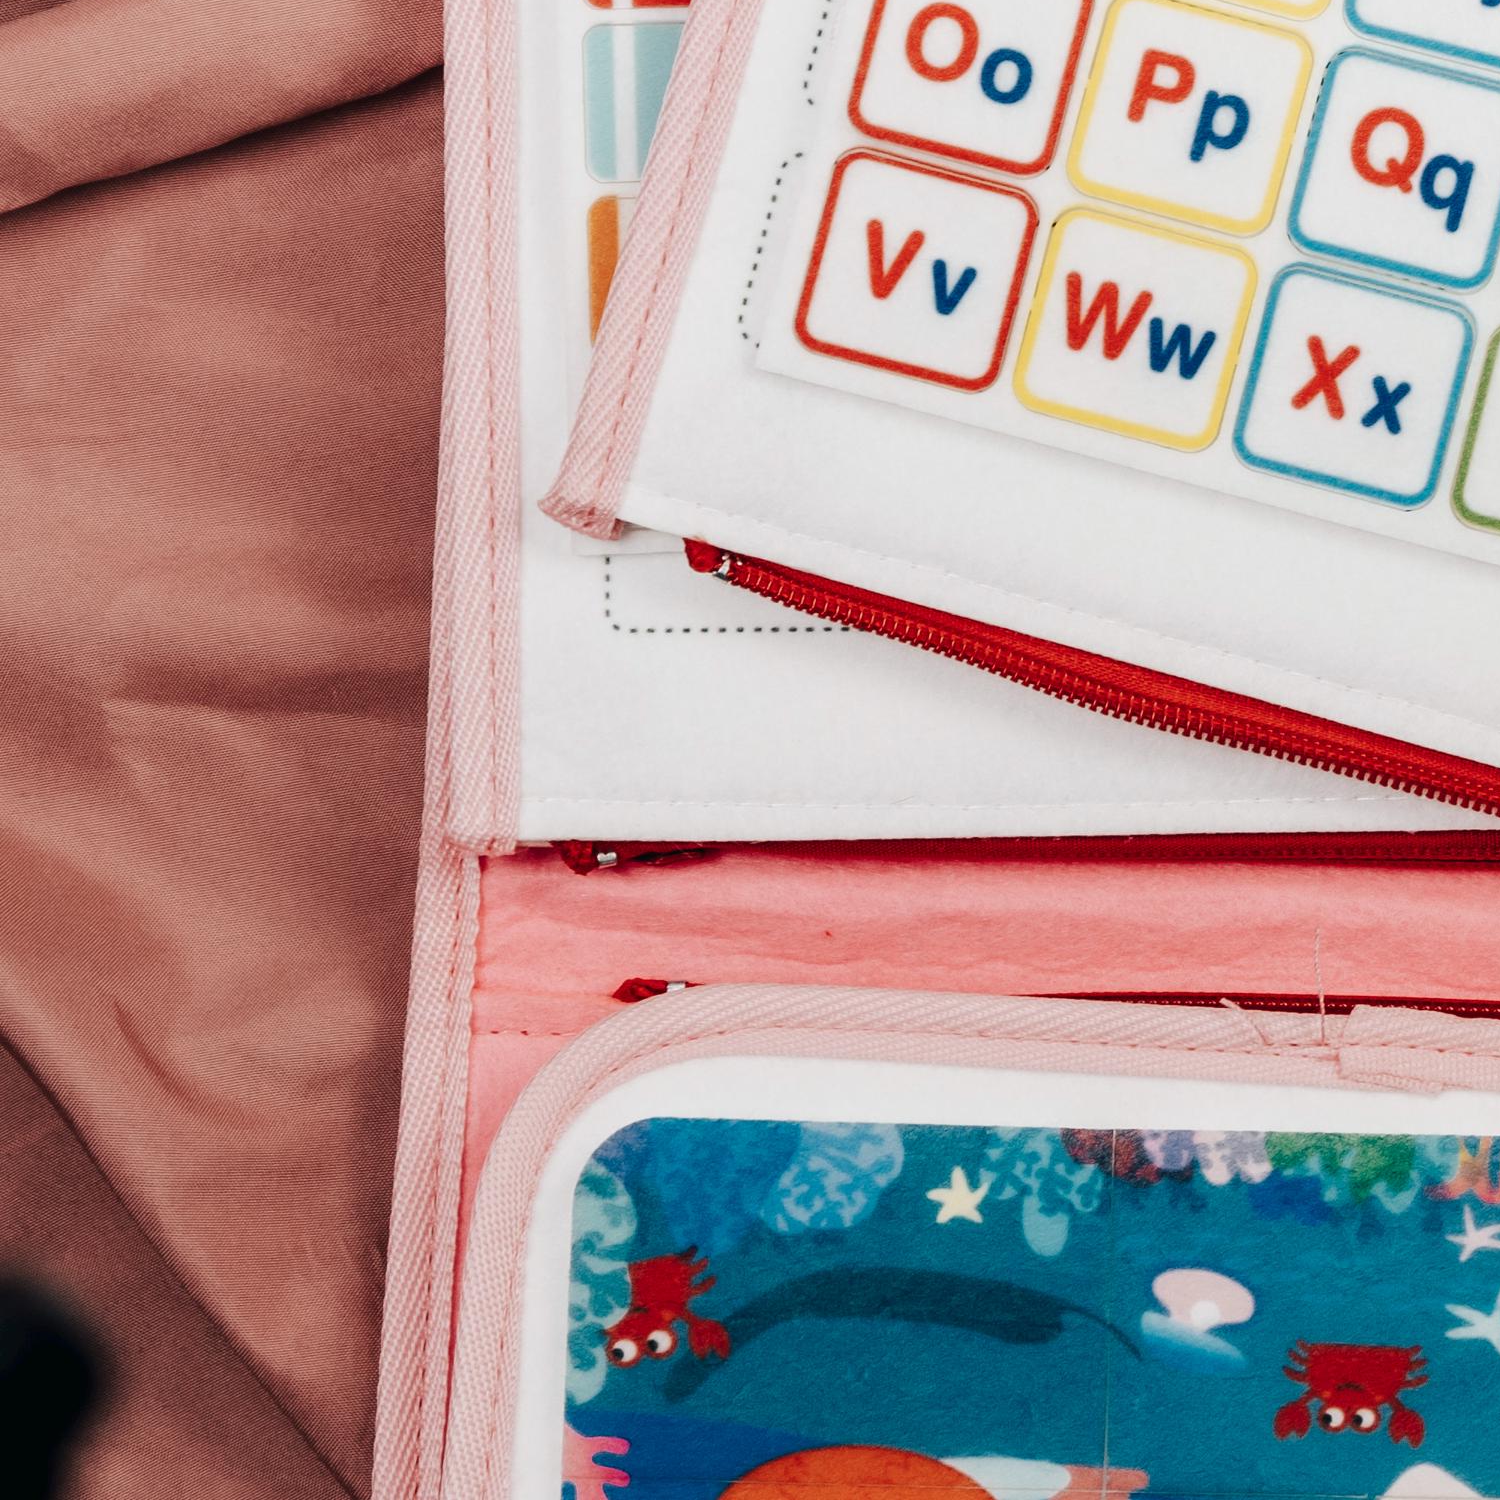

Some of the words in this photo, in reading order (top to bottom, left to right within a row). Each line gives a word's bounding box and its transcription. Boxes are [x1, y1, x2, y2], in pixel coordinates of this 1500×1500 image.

[905, 2, 1033, 104] Oo
[1127, 48, 1250, 162] Pp
[1351, 107, 1474, 232] Qq
[867, 219, 976, 315] Vv
[1065, 271, 1216, 380] Ww
[1291, 335, 1411, 434] Xx
